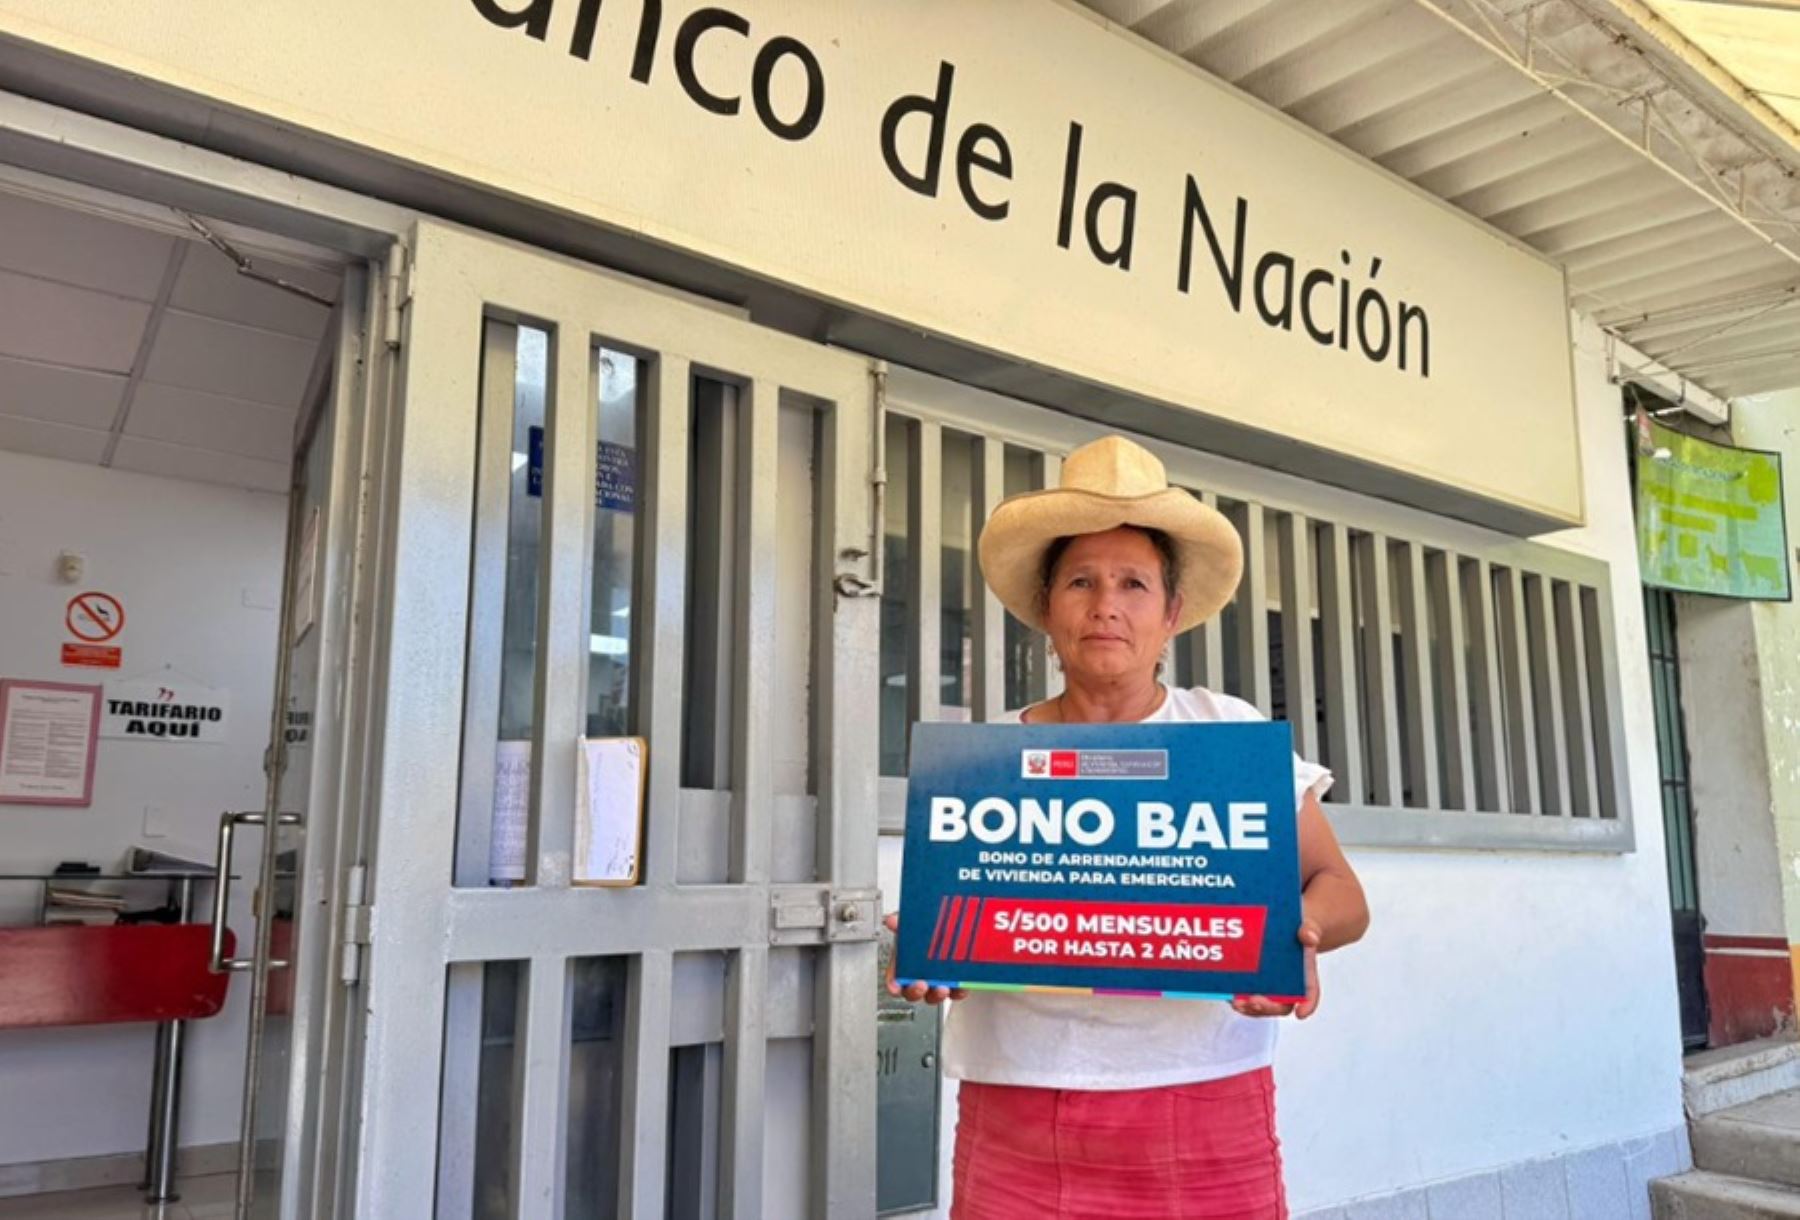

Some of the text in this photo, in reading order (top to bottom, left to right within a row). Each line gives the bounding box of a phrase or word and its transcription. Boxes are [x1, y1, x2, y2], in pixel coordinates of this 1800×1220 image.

[880, 60, 1014, 222] de
[1056, 121, 1138, 271] la
[1176, 173, 1430, 379] Nación
[107, 698, 223, 723] TARIFARIO
[928, 796, 1270, 851] BONO BAE
[978, 851, 1209, 869] BONO DE ARRENDAMIENTO
[958, 867, 1236, 889] DE VIVIENDA PARA EMERGENCIA
[993, 908, 1245, 940] S/500 MENSUALES
[1012, 937, 1225, 962] POR HASTA 2 AÑOS
